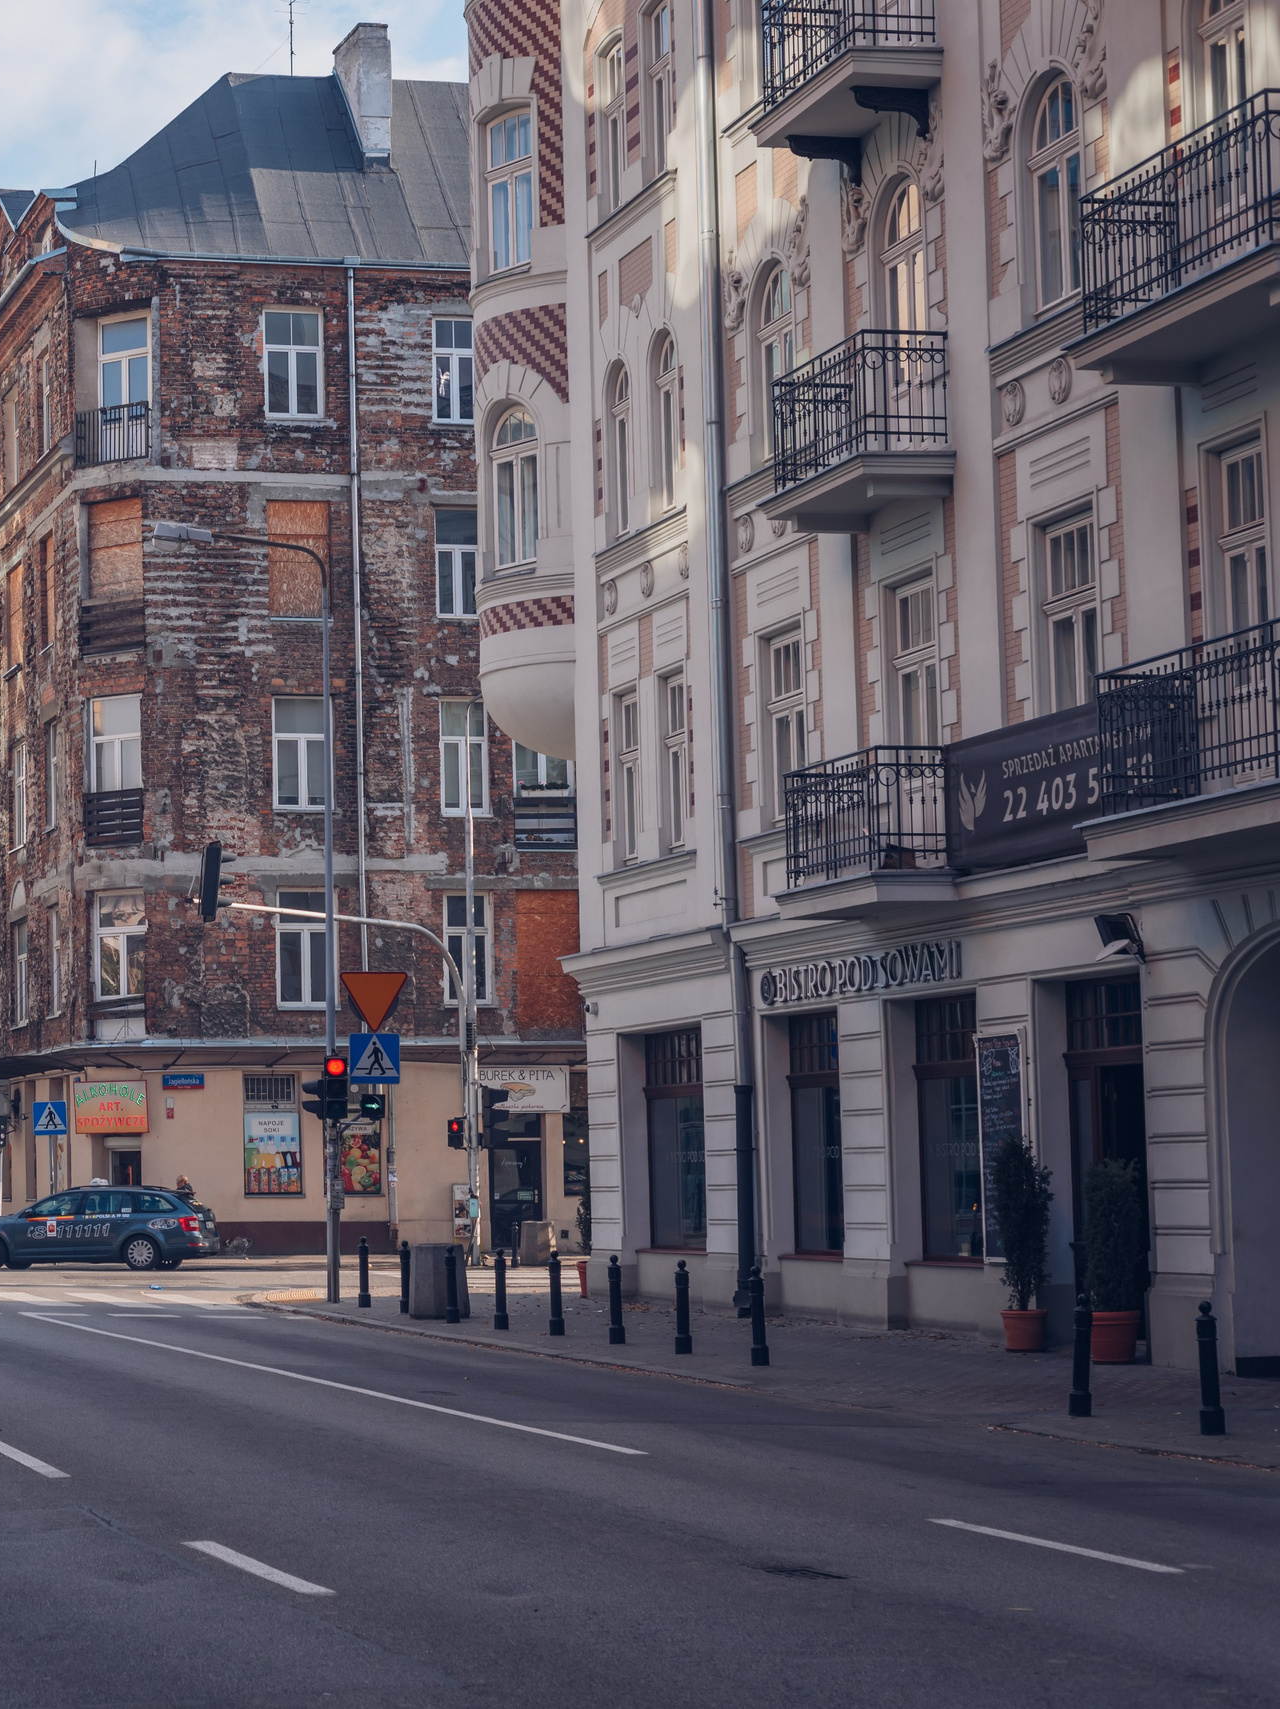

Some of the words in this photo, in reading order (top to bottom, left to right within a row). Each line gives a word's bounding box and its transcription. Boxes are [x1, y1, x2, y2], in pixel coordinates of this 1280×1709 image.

[1002, 744, 1057, 779] SPRZEDAŻ
[1002, 786, 1027, 822] 22
[1036, 772, 1077, 816] 403
[773, 960, 833, 1002] BISTRO
[833, 955, 876, 995] POD
[875, 939, 962, 989] SOWAMI
[168, 1077, 200, 1086] Jagiellońska
[479, 1069, 516, 1082] BUREK
[517, 1069, 527, 1081] &
[529, 1069, 556, 1081] PITA
[75, 1083, 146, 1107] ALKOHOLE
[99, 1101, 123, 1112] ART.
[77, 1115, 146, 1128] SPOŻYWCZE
[258, 1119, 285, 1127] NAPOJE
[32, 1225, 47, 1240] 8
